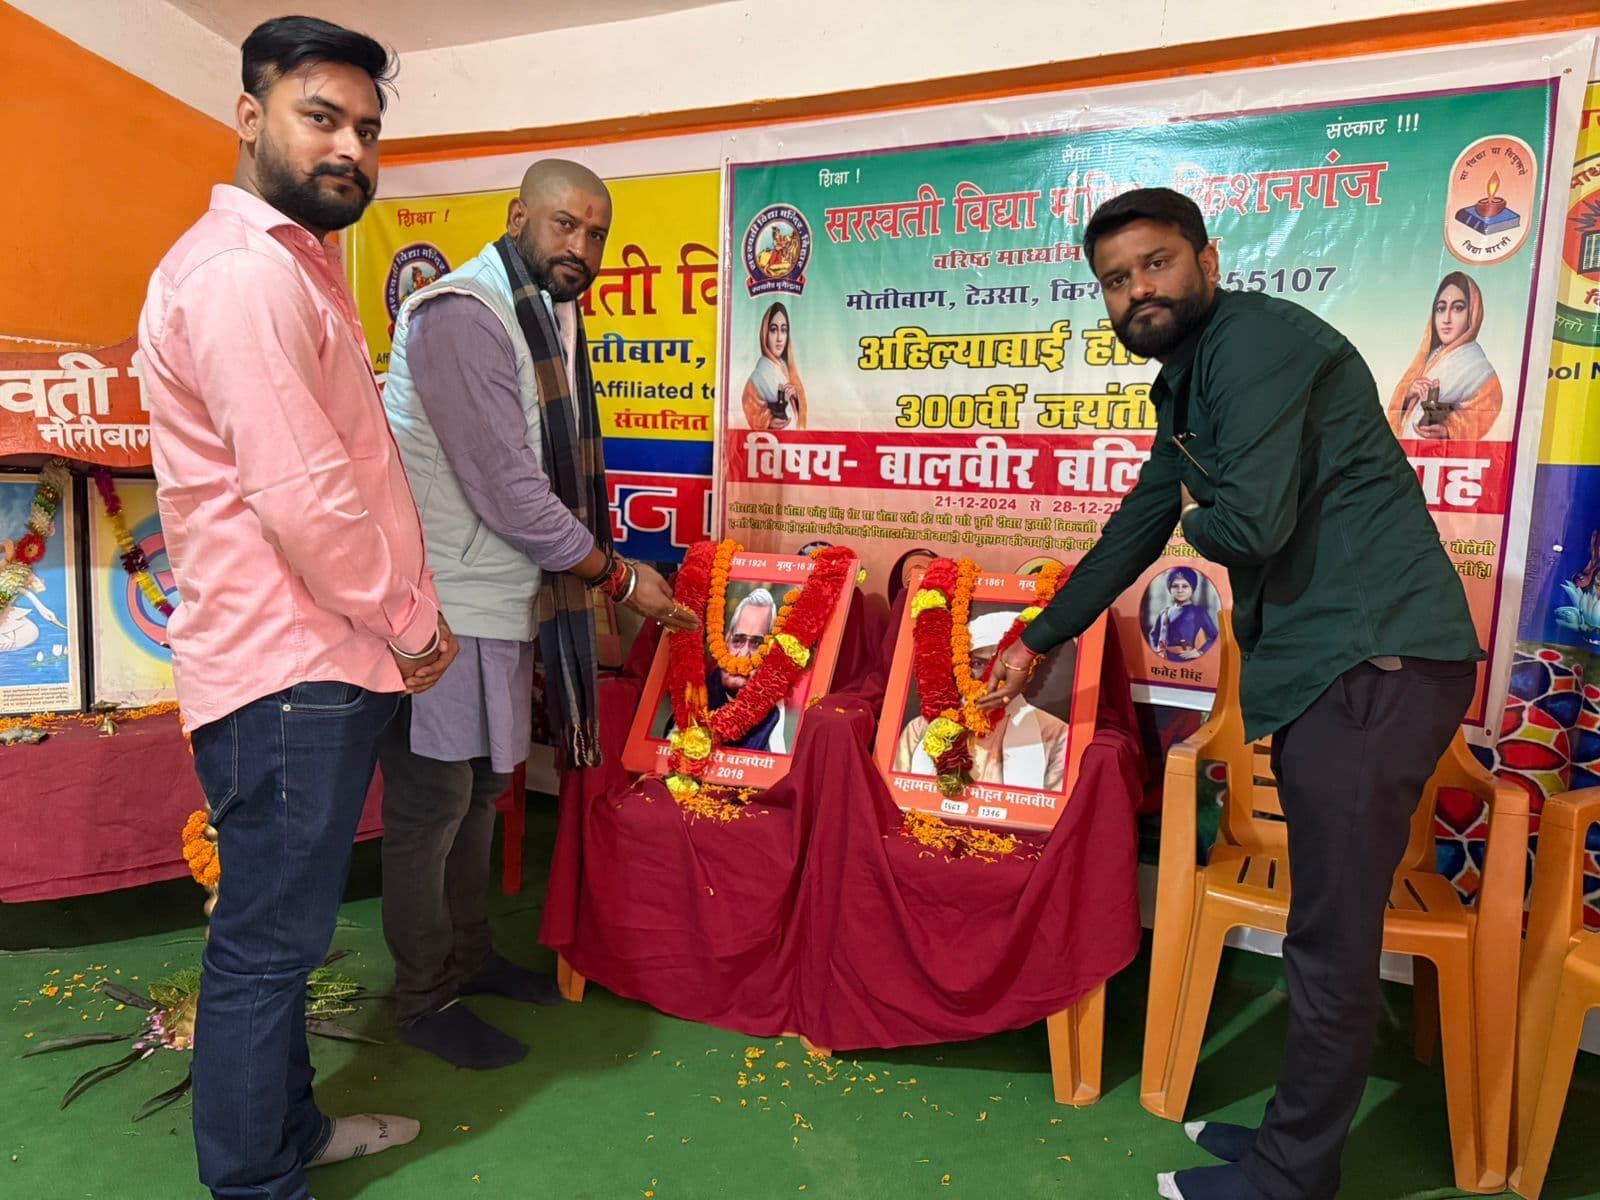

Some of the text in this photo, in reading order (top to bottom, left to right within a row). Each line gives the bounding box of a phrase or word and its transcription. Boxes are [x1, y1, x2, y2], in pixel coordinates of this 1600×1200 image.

[1325, 112, 1419, 139] संस्कार !!!
[818, 169, 849, 188] शिक्षा
[397, 208, 437, 228] शिक्षा
[824, 184, 946, 244] सरस्वती
[953, 181, 1041, 235] विद्या
[933, 242, 1083, 270] वरिष्ठ माध्यमि
[1462, 236, 1512, 255] विद्या भारती
[846, 286, 957, 312] मोतीबाग,
[1218, 266, 1338, 294] 55107
[588, 332, 706, 369] तीबाग,
[857, 320, 1072, 373] अहिल्याबाई
[593, 379, 693, 400] Affiliated
[895, 382, 1159, 430] 300वीं जयंती
[614, 408, 710, 432] संचालित
[744, 430, 859, 482] विषय-
[876, 435, 1039, 491] बालवीर
[934, 495, 1017, 511] 21-12-2024
[1029, 498, 1041, 512] से
[996, 515, 1023, 529] दीवार
[1055, 519, 1097, 533] निकलती
[1451, 539, 1496, 556] बोलेगी
[748, 559, 767, 567] 1924
[984, 578, 1004, 587] 1861
[1150, 665, 1203, 681] फतेह सिंह
[717, 767, 744, 780] 2018
[970, 783, 1003, 802] मोहन
[1005, 789, 1057, 809] मालवीय
